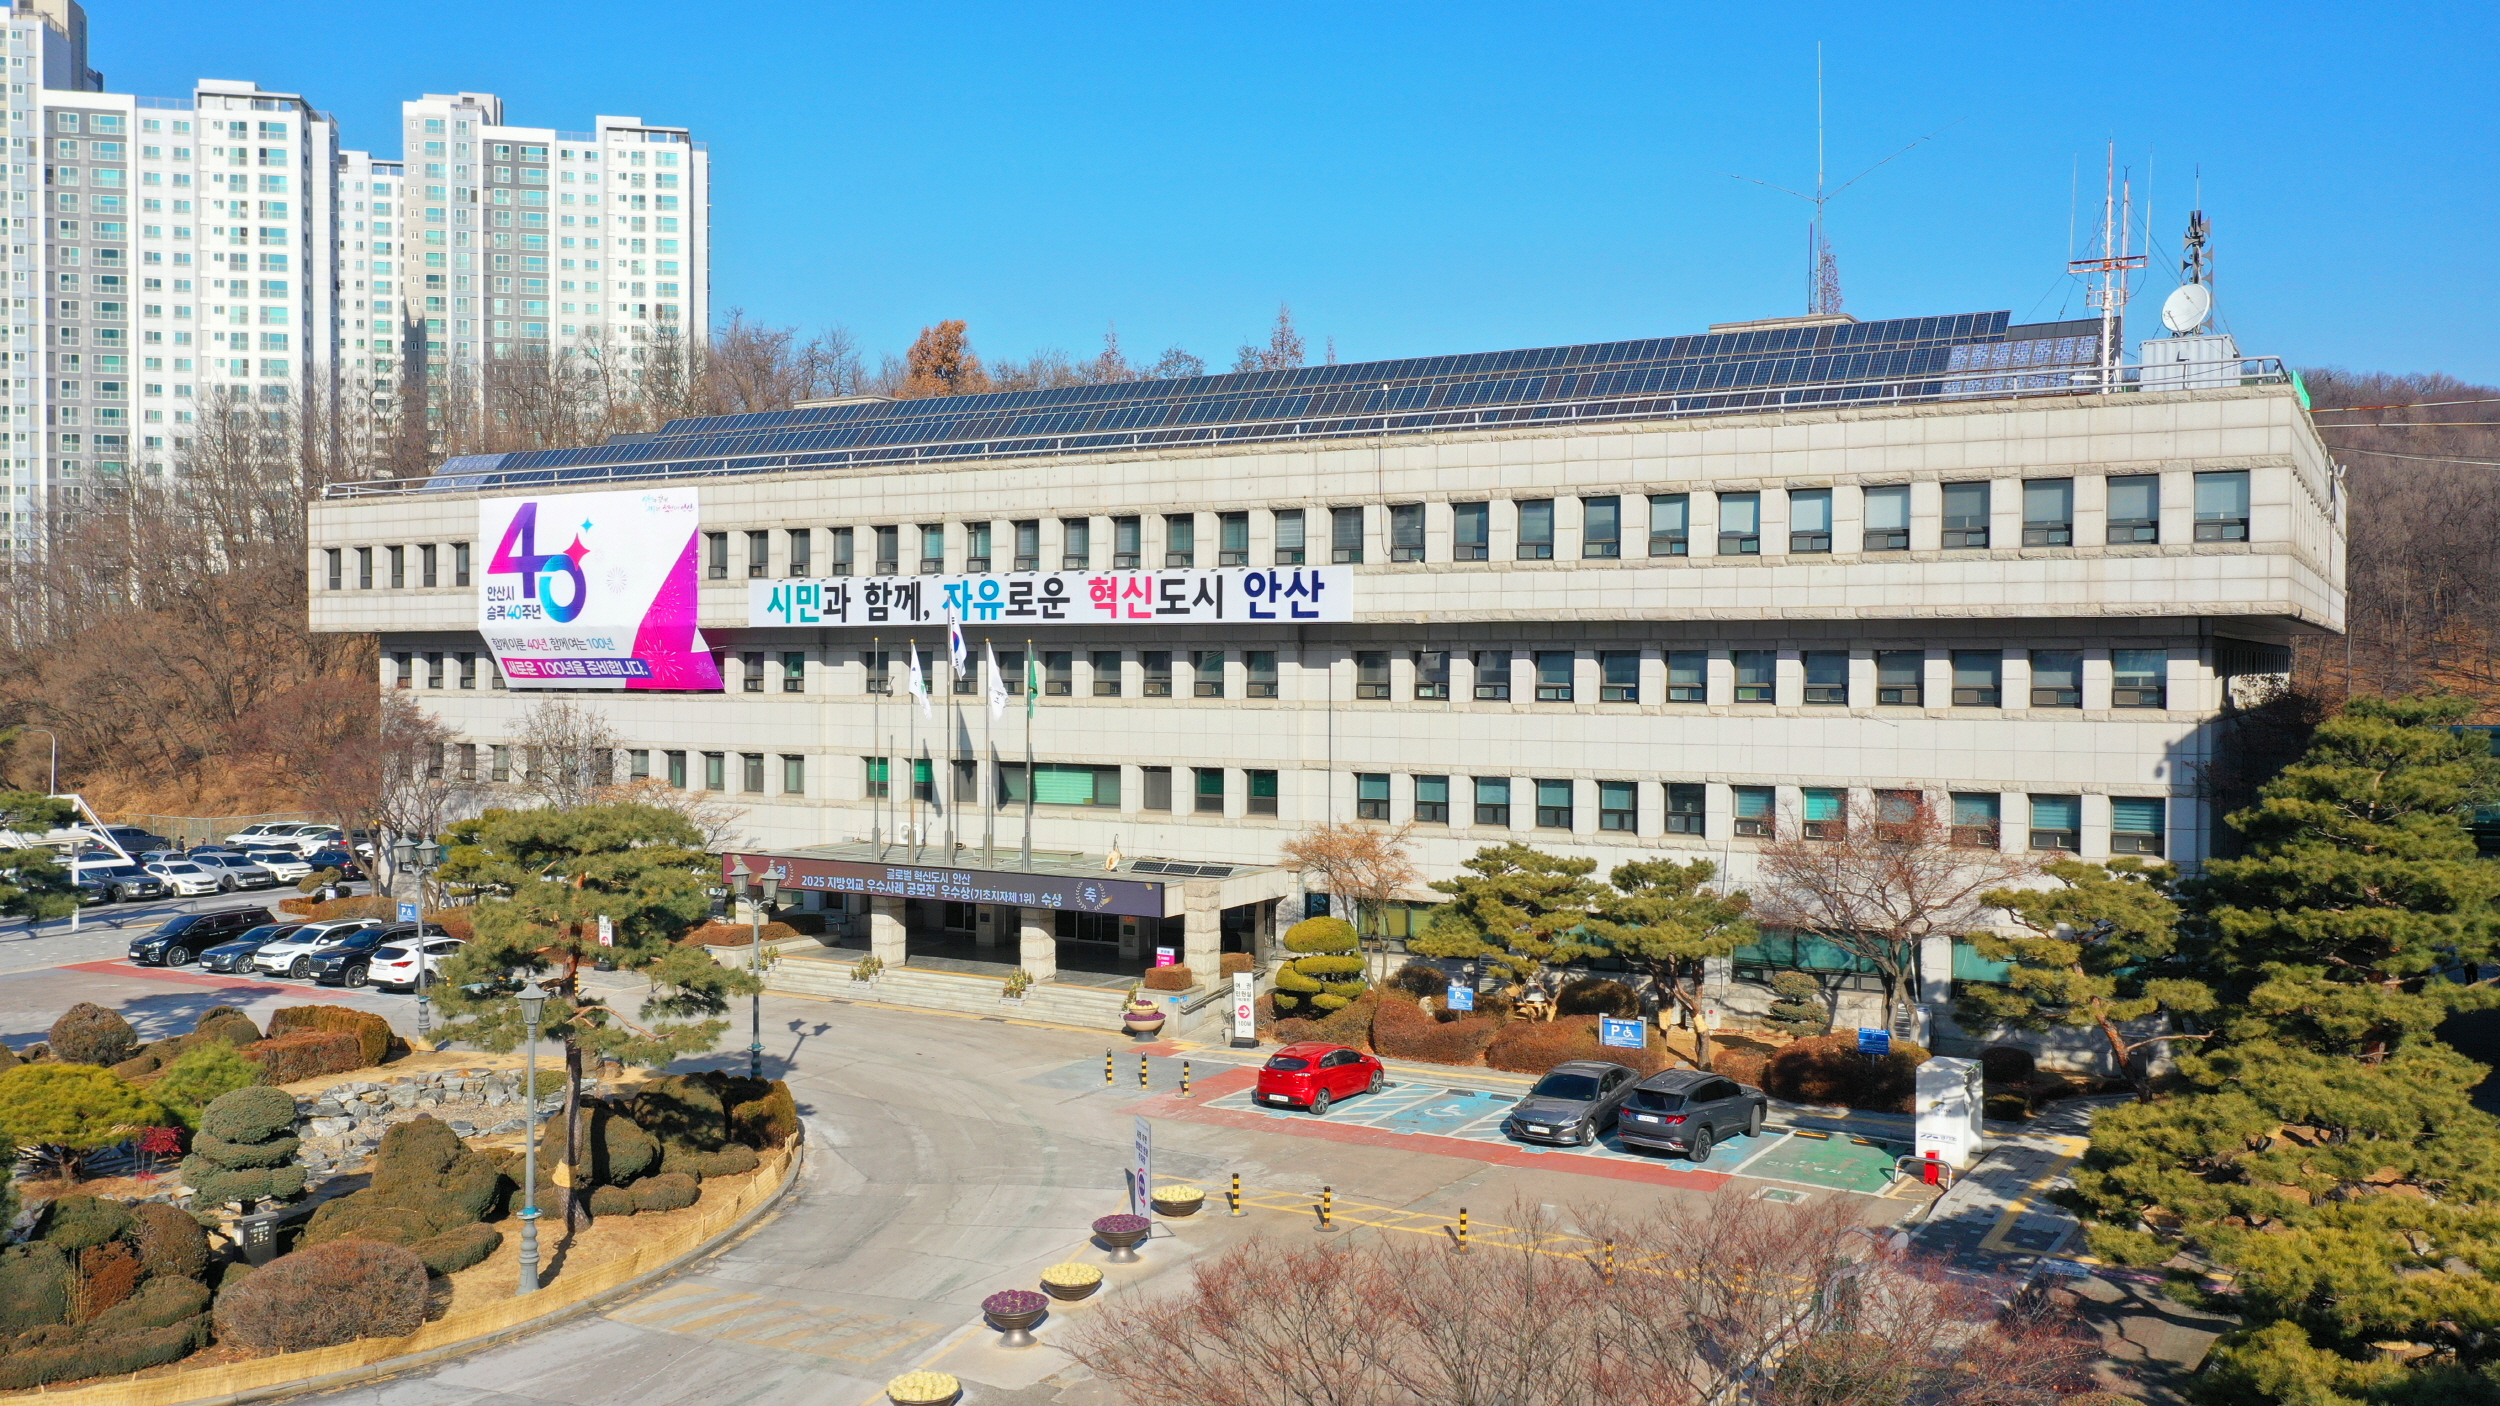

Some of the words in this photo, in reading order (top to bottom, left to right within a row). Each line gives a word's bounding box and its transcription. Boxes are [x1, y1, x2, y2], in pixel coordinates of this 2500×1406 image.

[487, 585, 515, 602] 안산시
[767, 583, 851, 624] 시민과
[864, 581, 930, 622] 함께,
[942, 577, 1071, 622] 자유로운
[1088, 574, 1223, 619] 혁신도시
[1243, 570, 1325, 619] 안산
[505, 660, 539, 676] 새로운
[537, 660, 588, 676] 100년을
[585, 660, 649, 676] 준비합니다.
[886, 868, 912, 881] 글로벌
[914, 870, 949, 884] 혁신도시
[952, 872, 971, 886] 안산
[801, 875, 825, 888] 2025
[827, 876, 865, 891] 지방외교
[866, 878, 904, 894] 우수사례
[906, 882, 936, 897] 공모전
[1018, 893, 1036, 905] 1위)
[1040, 892, 1063, 907] 수상
[1083, 886, 1097, 903] 축
[401, 907, 406, 916] P
[1454, 991, 1461, 1000] P
[1611, 1024, 1620, 1036] P
